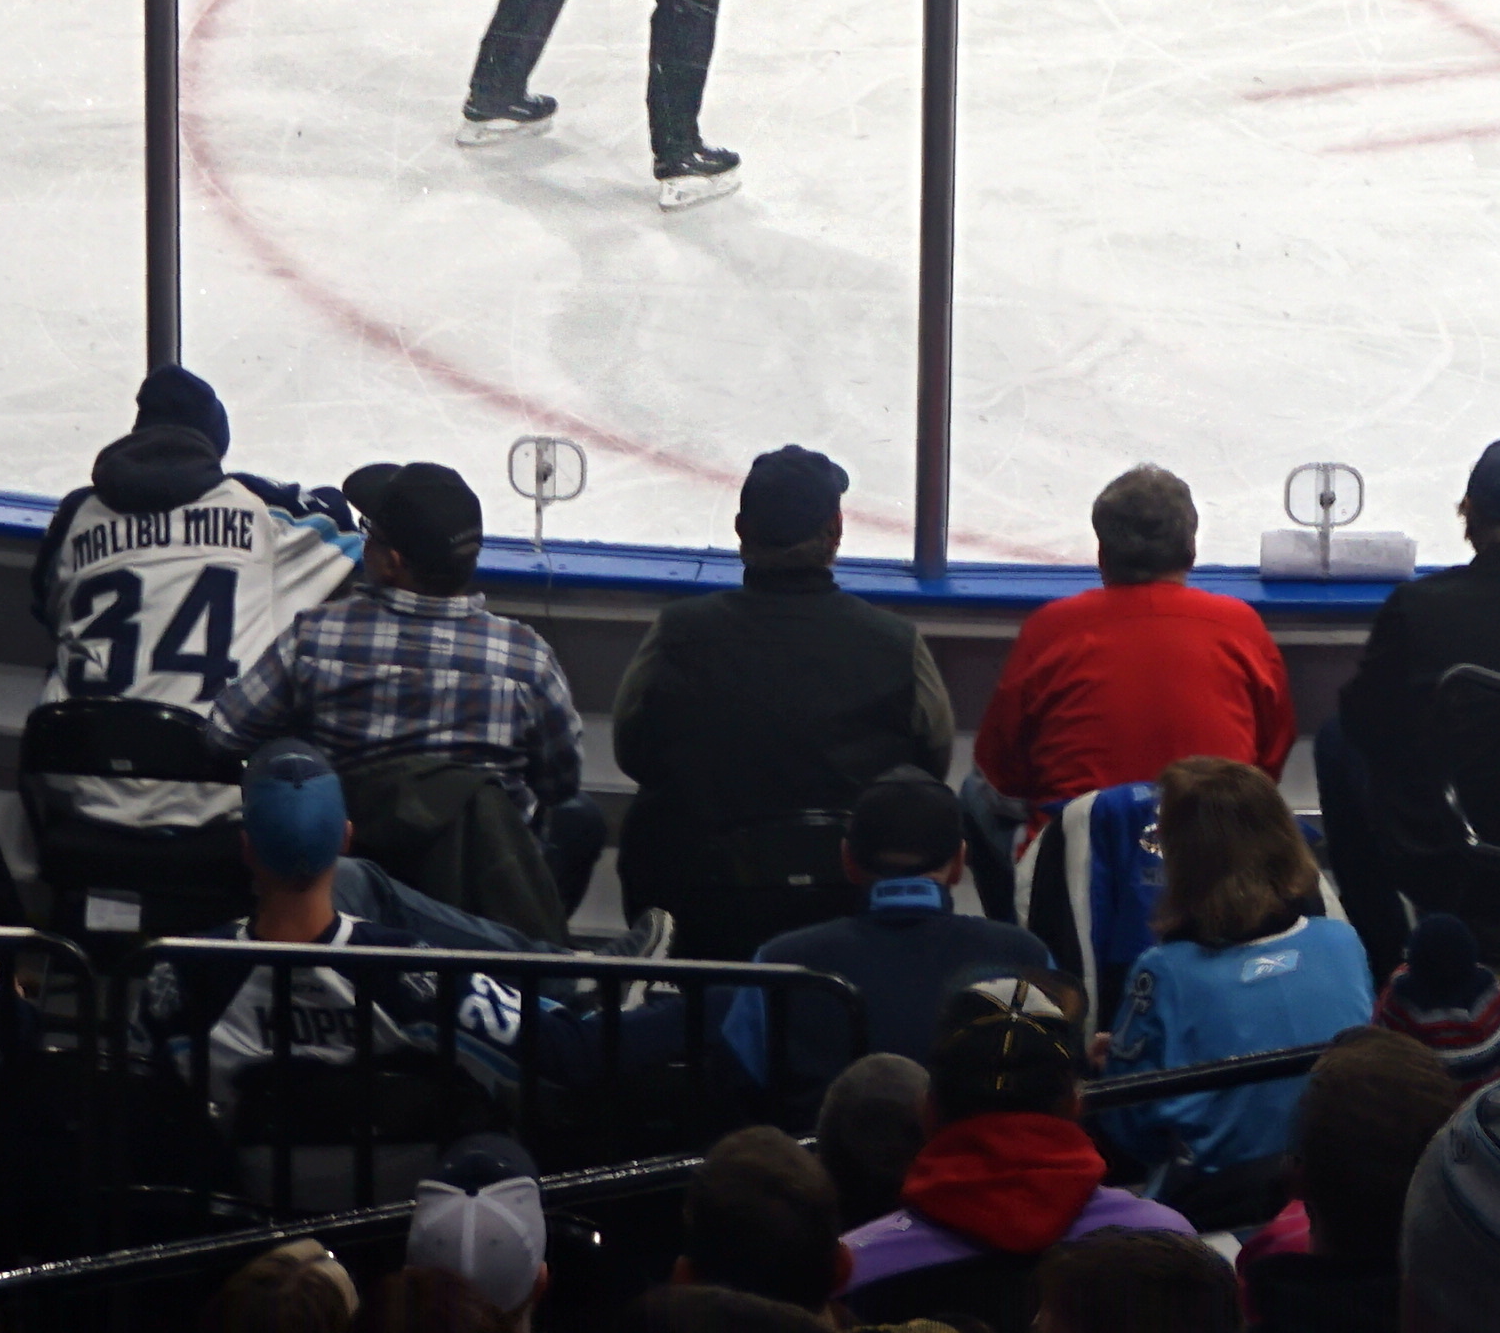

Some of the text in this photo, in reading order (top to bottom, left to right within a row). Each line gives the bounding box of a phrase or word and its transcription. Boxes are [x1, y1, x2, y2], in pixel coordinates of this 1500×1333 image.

[71, 507, 254, 573] MALIBU MIKE
[66, 563, 241, 702] 34
